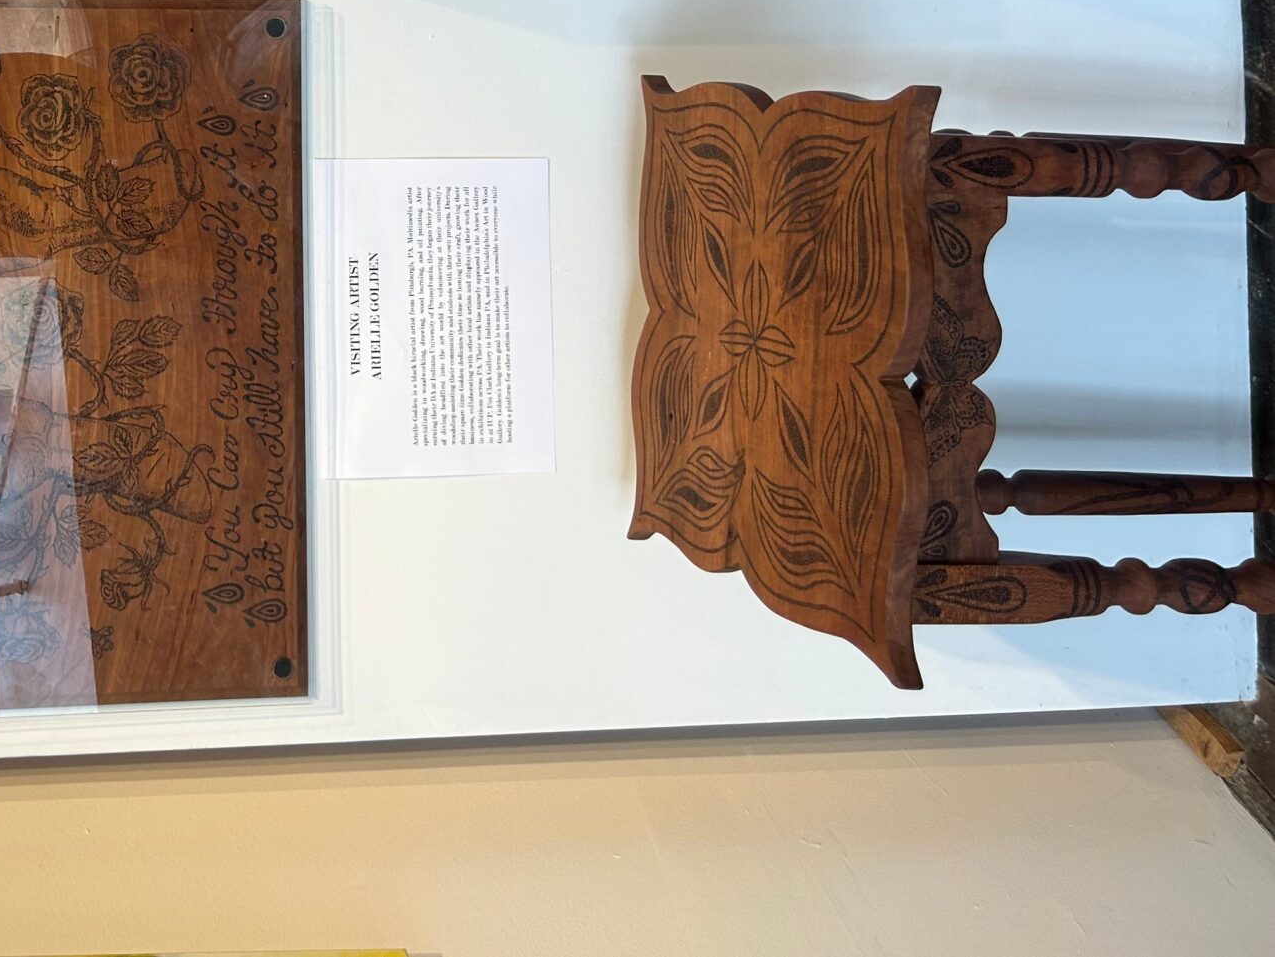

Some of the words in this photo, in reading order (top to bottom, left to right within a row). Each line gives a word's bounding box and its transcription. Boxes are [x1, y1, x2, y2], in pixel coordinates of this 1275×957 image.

[199, 143, 238, 188] it
[240, 121, 277, 169] it
[238, 180, 279, 222] do
[348, 257, 360, 308] ARTIST
[368, 251, 381, 312] GOLDEN
[349, 313, 361, 375] VISITING
[370, 314, 382, 380] ARIELLE
[205, 347, 254, 421] Cry
[243, 381, 285, 457] still
[207, 430, 239, 491] Can
[204, 505, 250, 571] You
[244, 541, 285, 592] but
